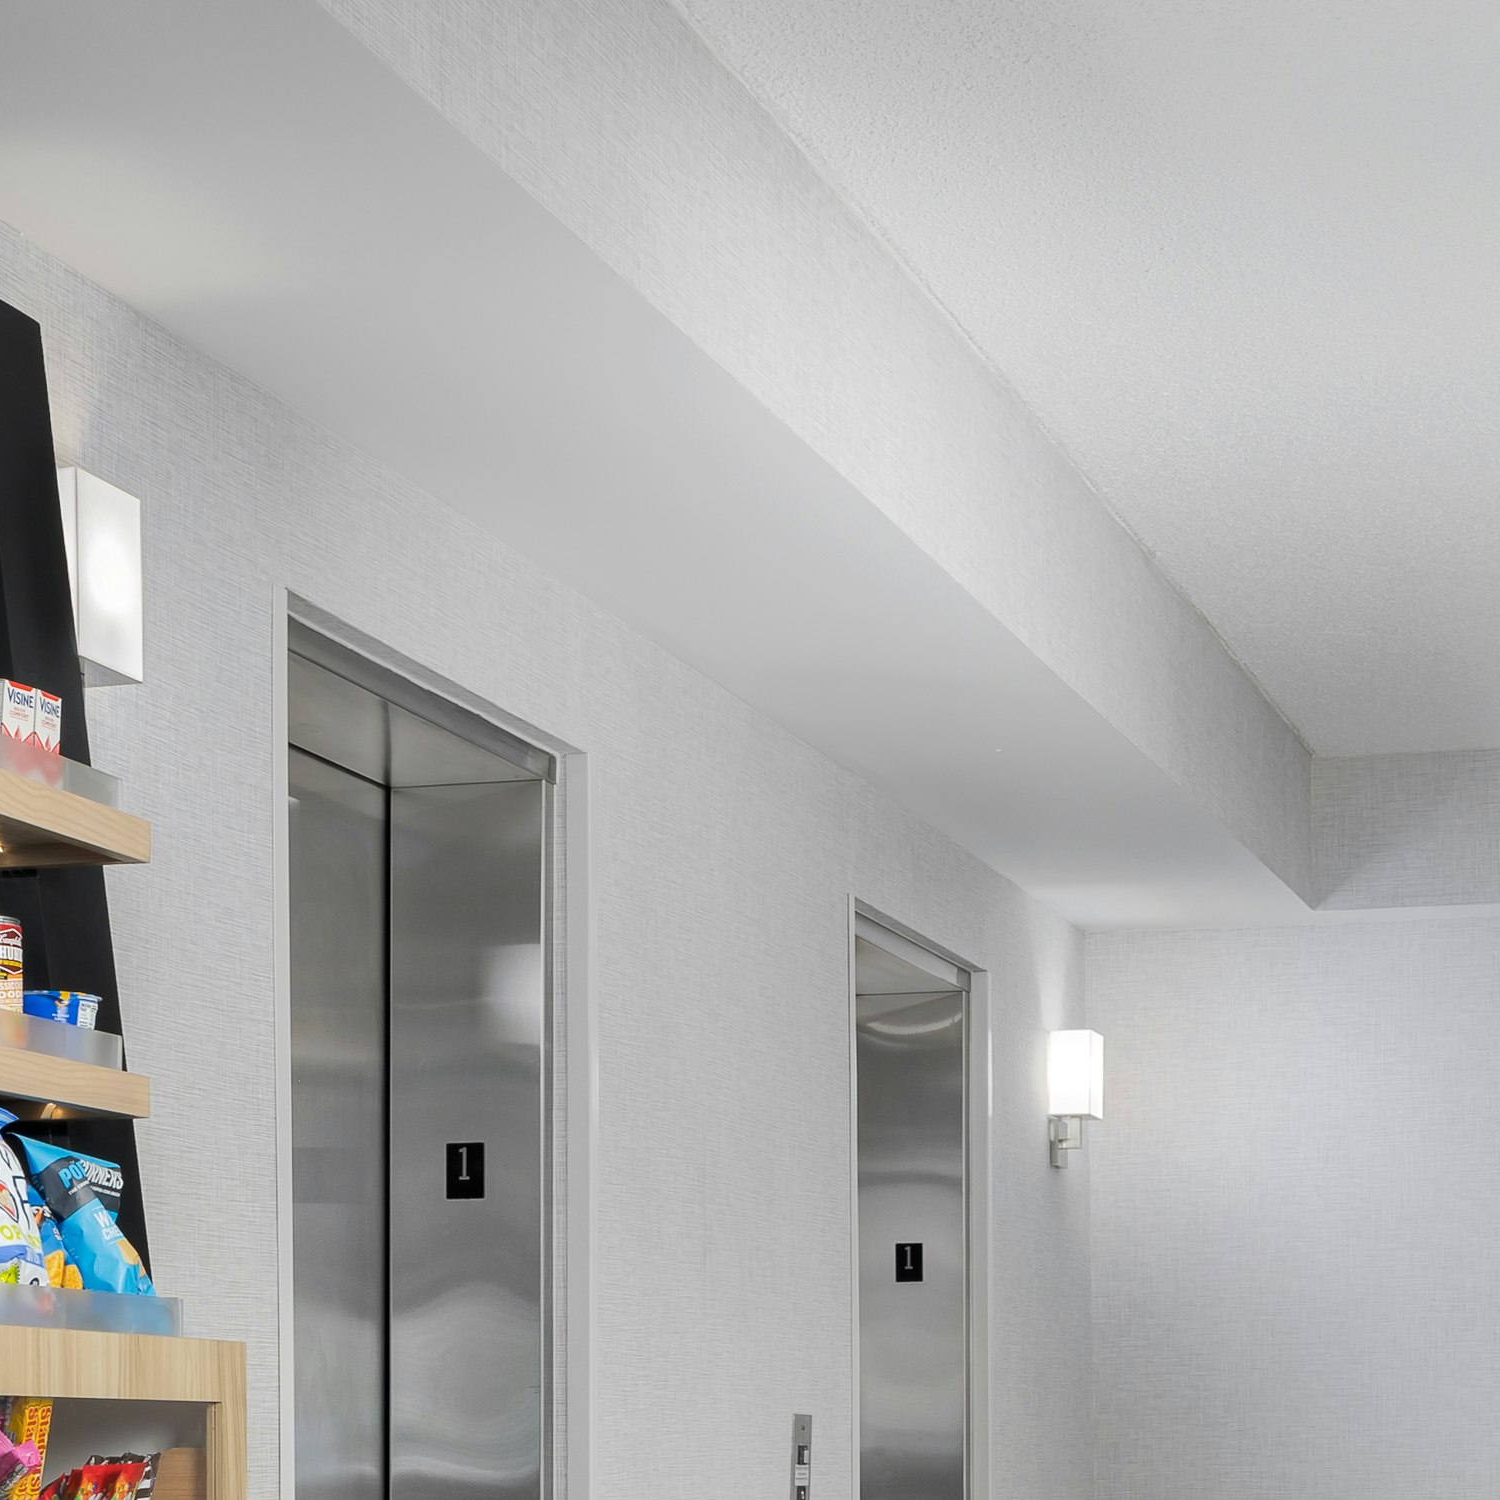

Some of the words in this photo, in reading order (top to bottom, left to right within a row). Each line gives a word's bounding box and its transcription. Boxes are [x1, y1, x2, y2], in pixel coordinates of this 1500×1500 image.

[8, 687, 34, 709] VISINE
[39, 697, 60, 718] VISINE
[459, 1146, 470, 1181] 1
[904, 1246, 913, 1270] 1
